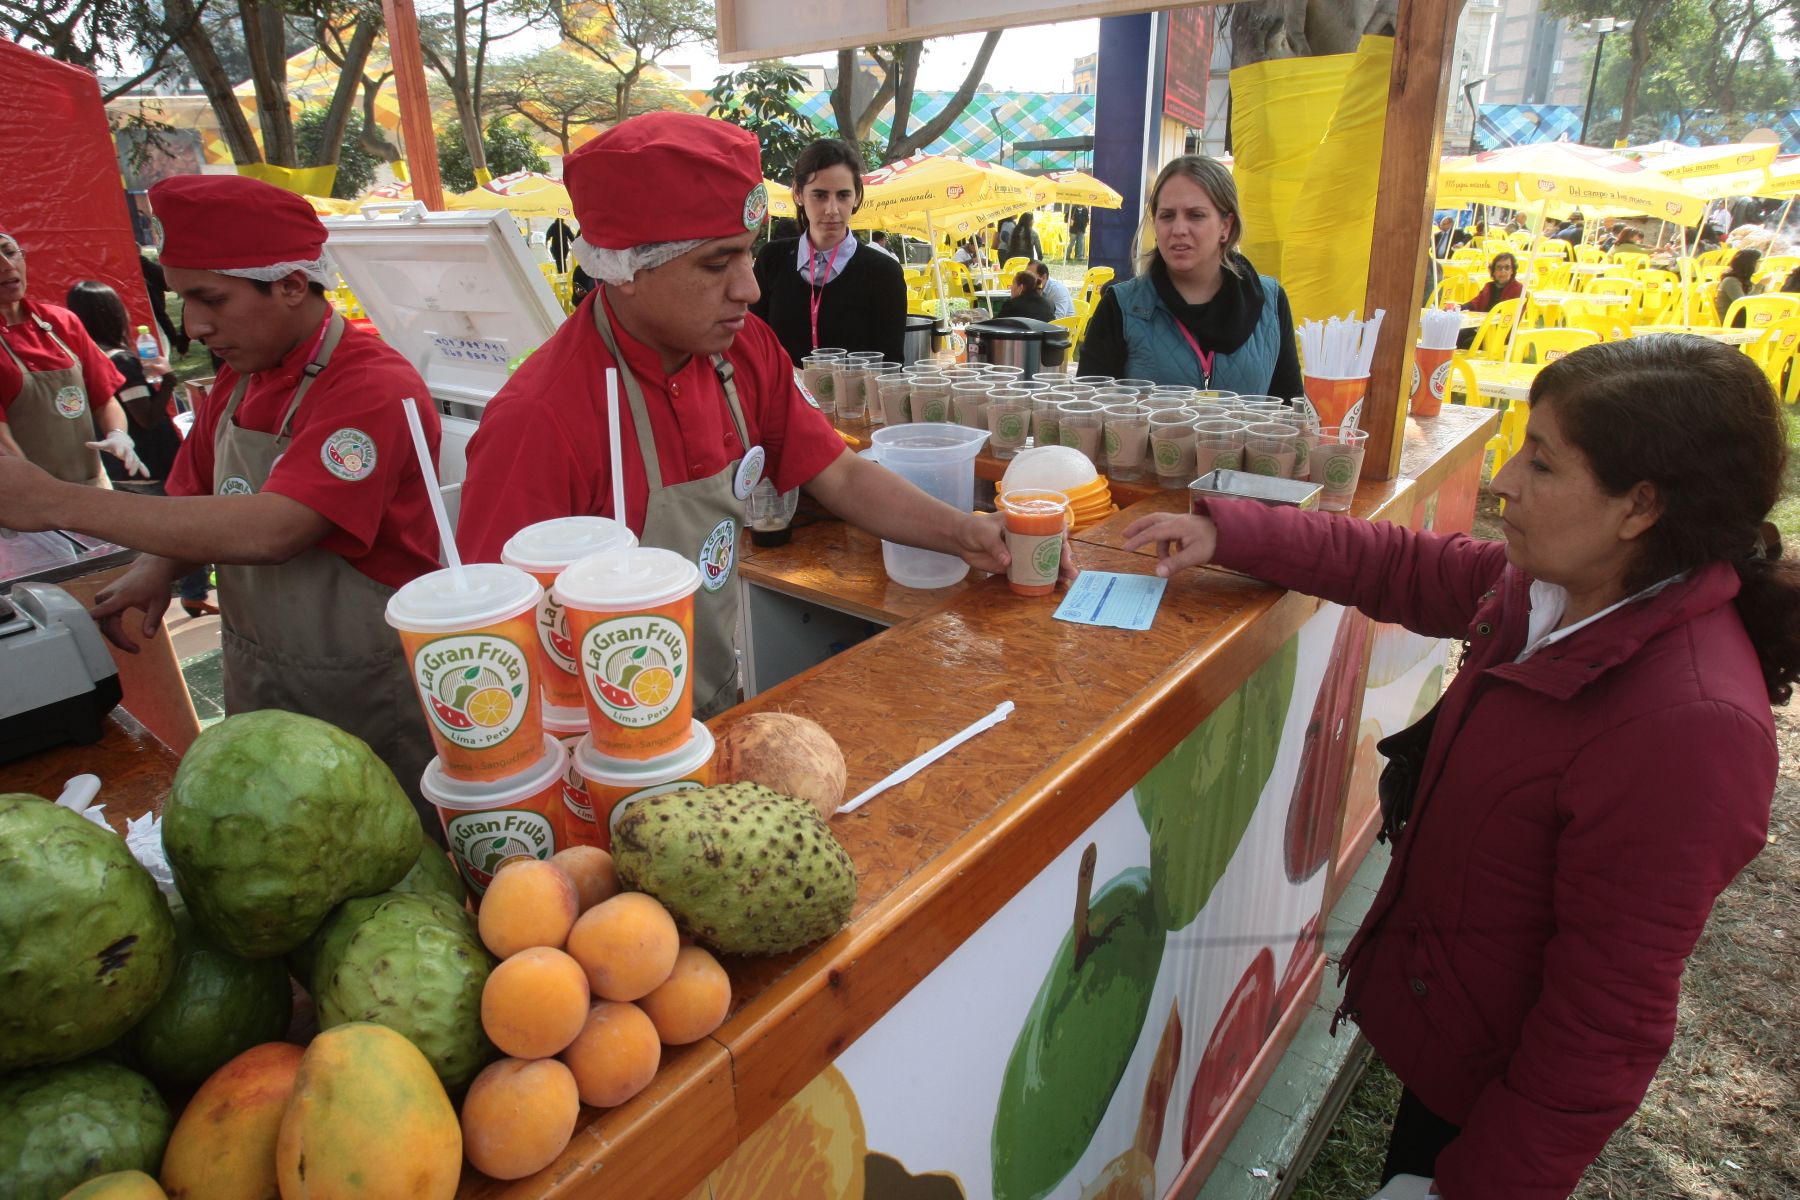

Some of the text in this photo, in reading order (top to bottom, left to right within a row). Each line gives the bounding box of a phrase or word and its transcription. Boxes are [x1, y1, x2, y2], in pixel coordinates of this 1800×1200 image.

[947, 185, 964, 198] Lay's
[1569, 186, 1581, 196] Del
[701, 548, 711, 561] La
[707, 527, 726, 546] Gran
[541, 607, 557, 628] La
[586, 622, 682, 671] La Gran Fruta
[420, 642, 521, 692] La Gran Fruta
[613, 706, 670, 724] Lima Perú
[451, 727, 510, 745] Lima Perú
[454, 816, 546, 855] La Gran Fruta
